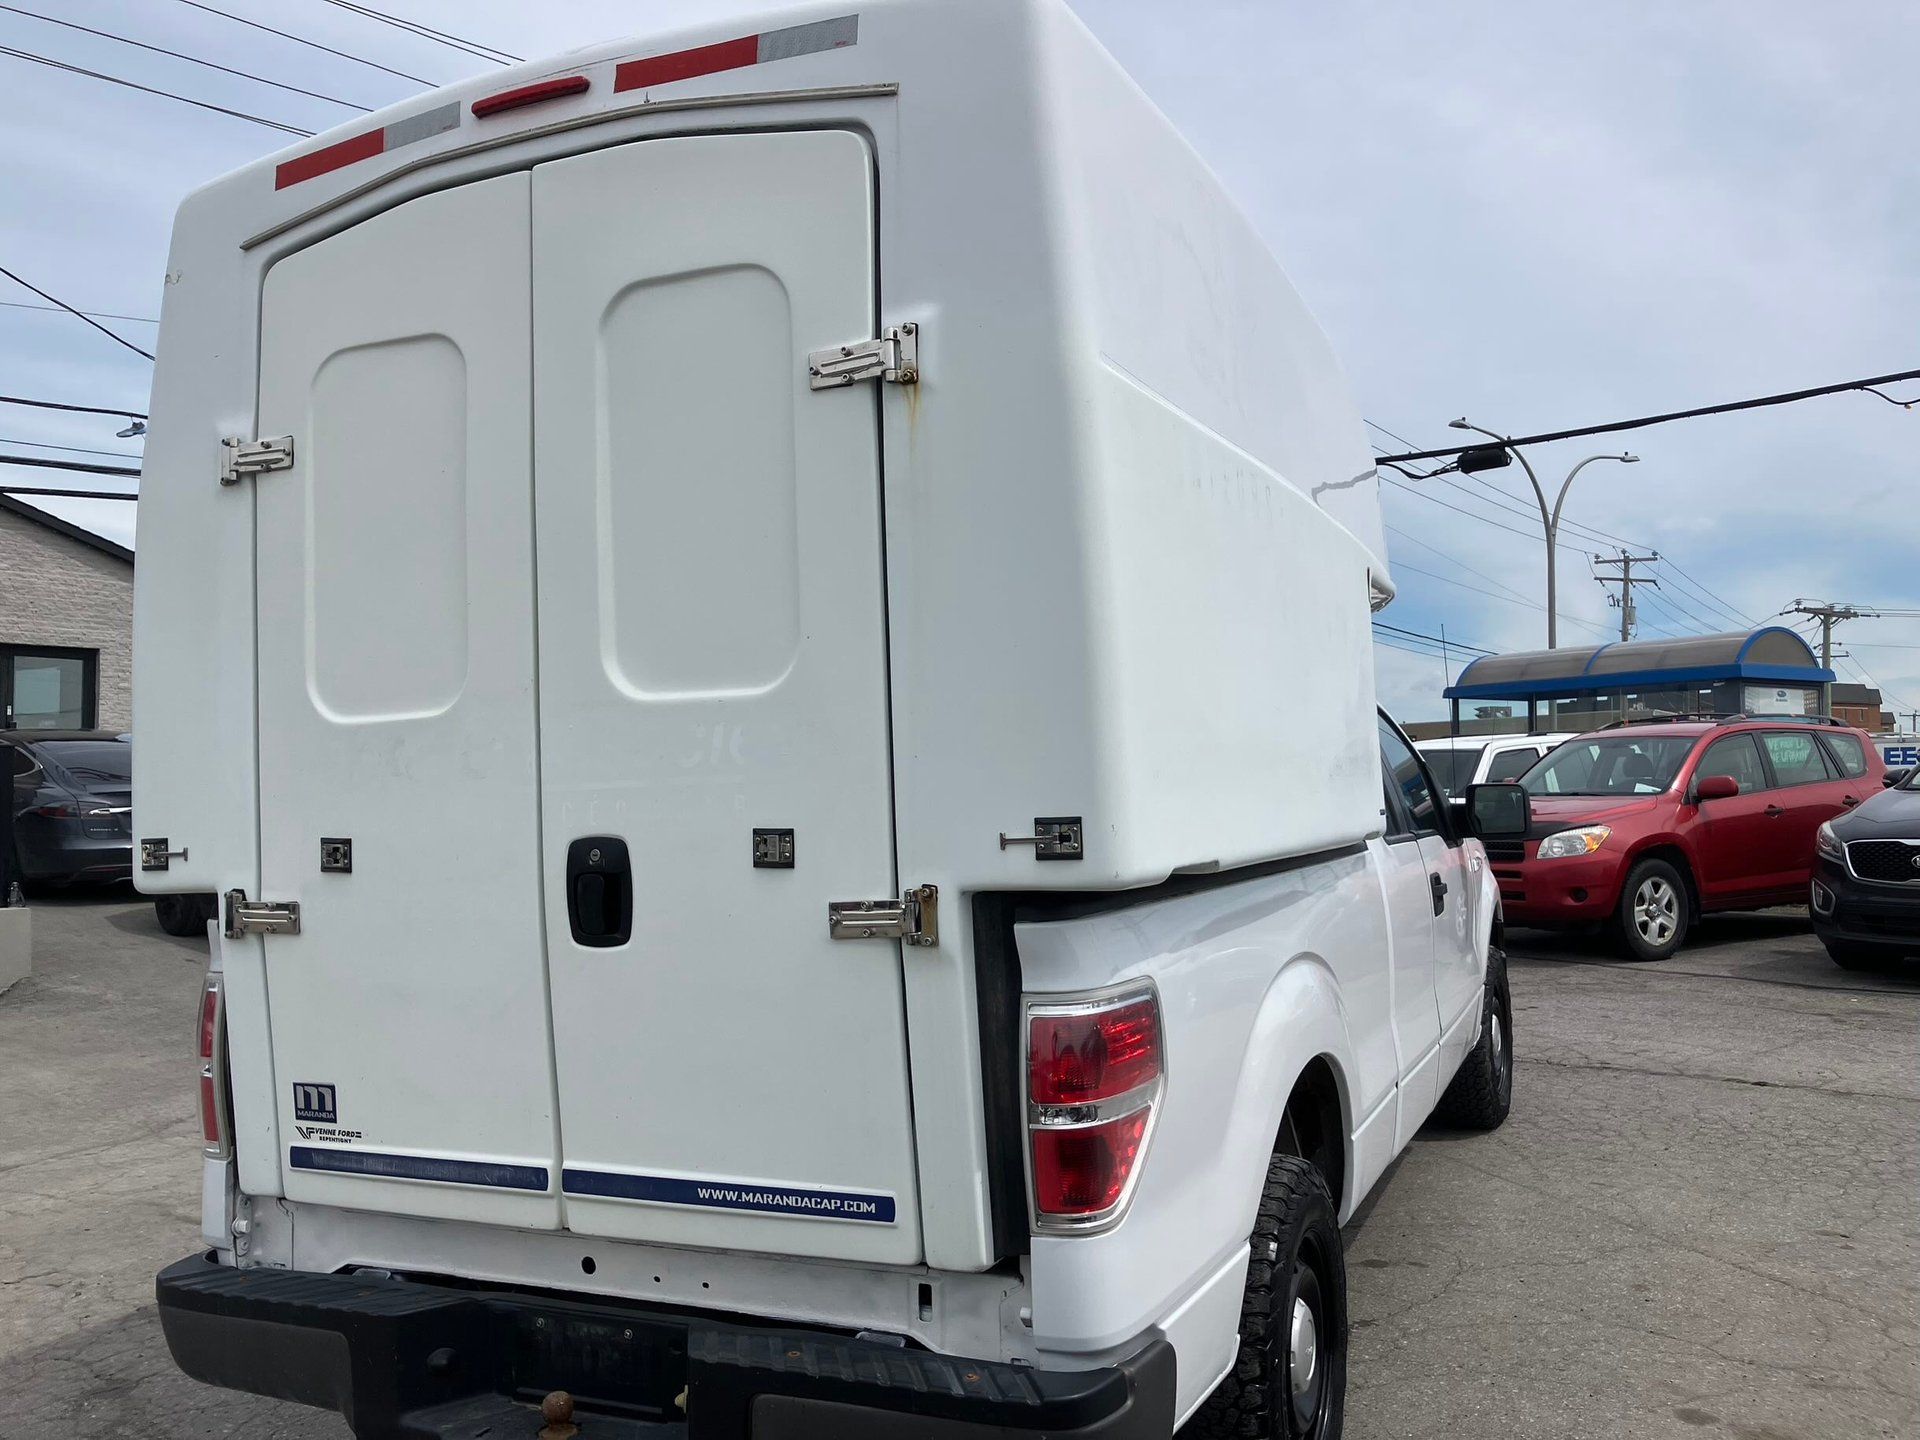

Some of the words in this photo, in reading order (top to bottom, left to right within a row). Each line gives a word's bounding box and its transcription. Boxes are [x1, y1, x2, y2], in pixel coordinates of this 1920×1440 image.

[1884, 746, 1920, 766] EE
[297, 1110, 335, 1119] MARANDA
[315, 1127, 336, 1136] VENNE
[337, 1129, 356, 1138] FORD
[697, 1187, 876, 1214] WWW.MARANDACAP.COM
